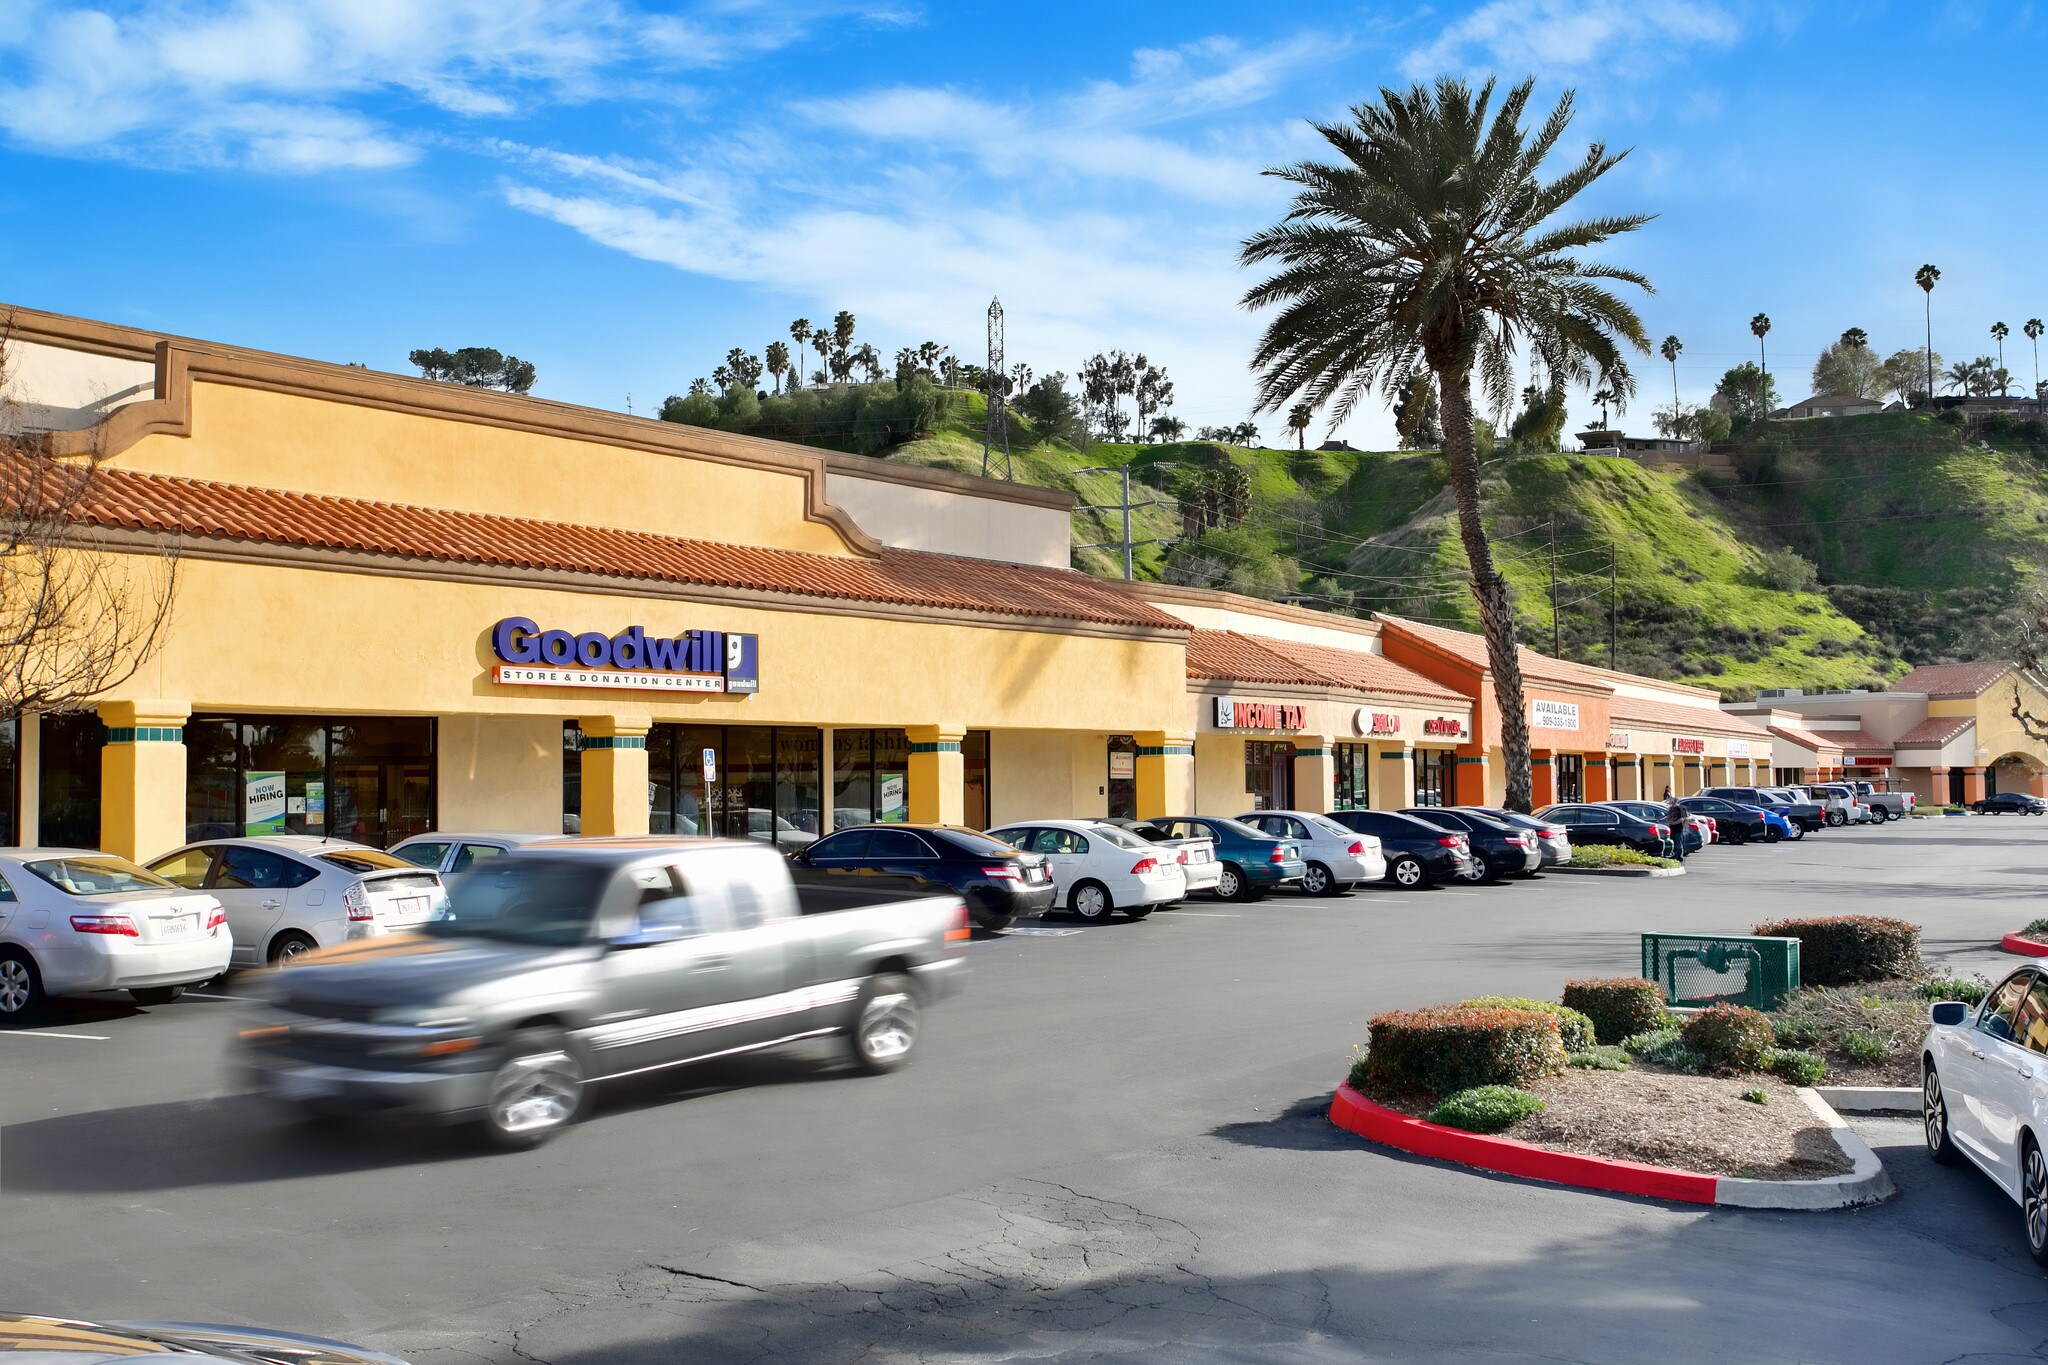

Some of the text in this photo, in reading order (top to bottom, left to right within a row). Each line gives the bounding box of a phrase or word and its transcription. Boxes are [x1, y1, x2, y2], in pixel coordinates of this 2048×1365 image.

[492, 616, 723, 672] Goodwill
[503, 670, 722, 689] STORE & DONATION CENTER
[728, 679, 757, 690] goodwill
[1233, 702, 1308, 730] INCOME TAX
[1536, 702, 1576, 716] AVAILABLE
[255, 784, 275, 794] NOW
[883, 787, 903, 799] HIRING
[886, 783, 898, 791] NOW
[248, 789, 284, 805] HIRING
